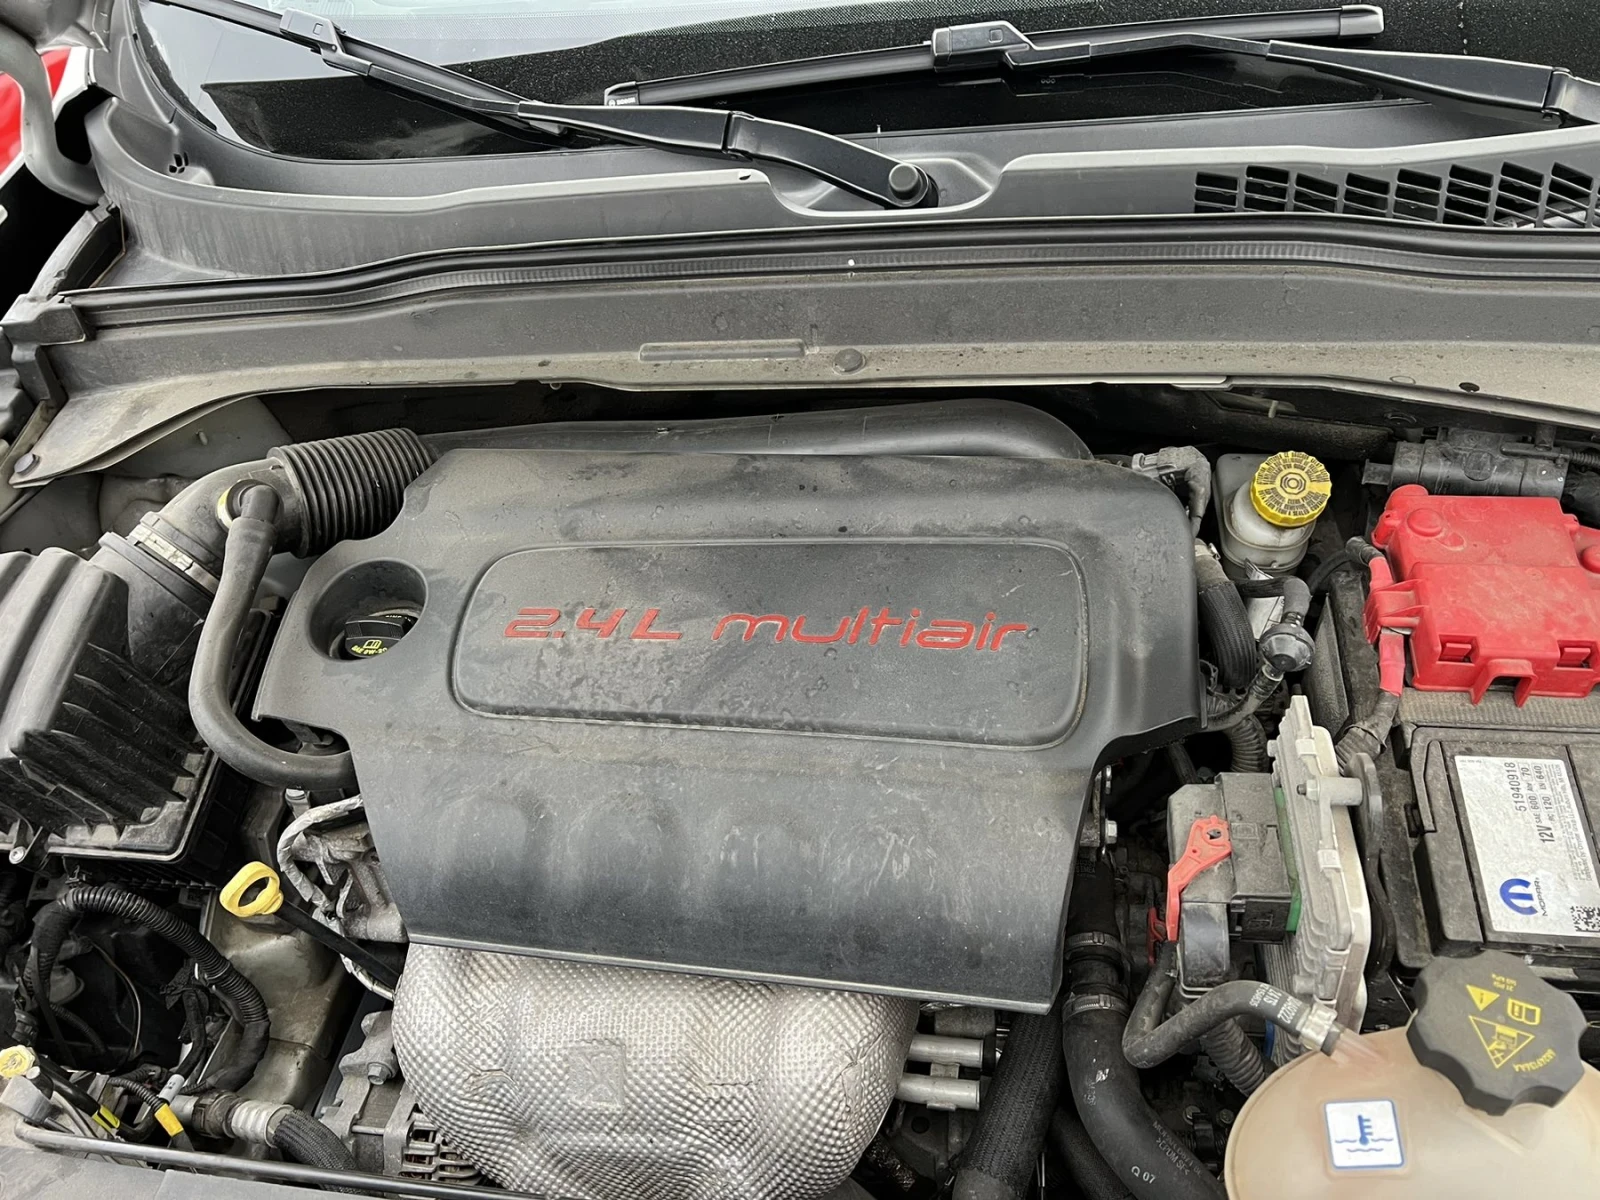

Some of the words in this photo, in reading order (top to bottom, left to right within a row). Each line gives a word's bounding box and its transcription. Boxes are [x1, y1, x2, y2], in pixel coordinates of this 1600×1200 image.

[710, 605, 1027, 652] multiair
[1521, 767, 1532, 777] 70
[1534, 765, 1545, 780] 640
[1504, 762, 1527, 812] 51940918
[1528, 795, 1540, 810] 600
[1542, 796, 1553, 810] 120
[1533, 813, 1543, 824] SAE
[1536, 825, 1555, 843] 12V
[1534, 879, 1548, 917] MOPAR
[1143, 1171, 1156, 1184] 07
